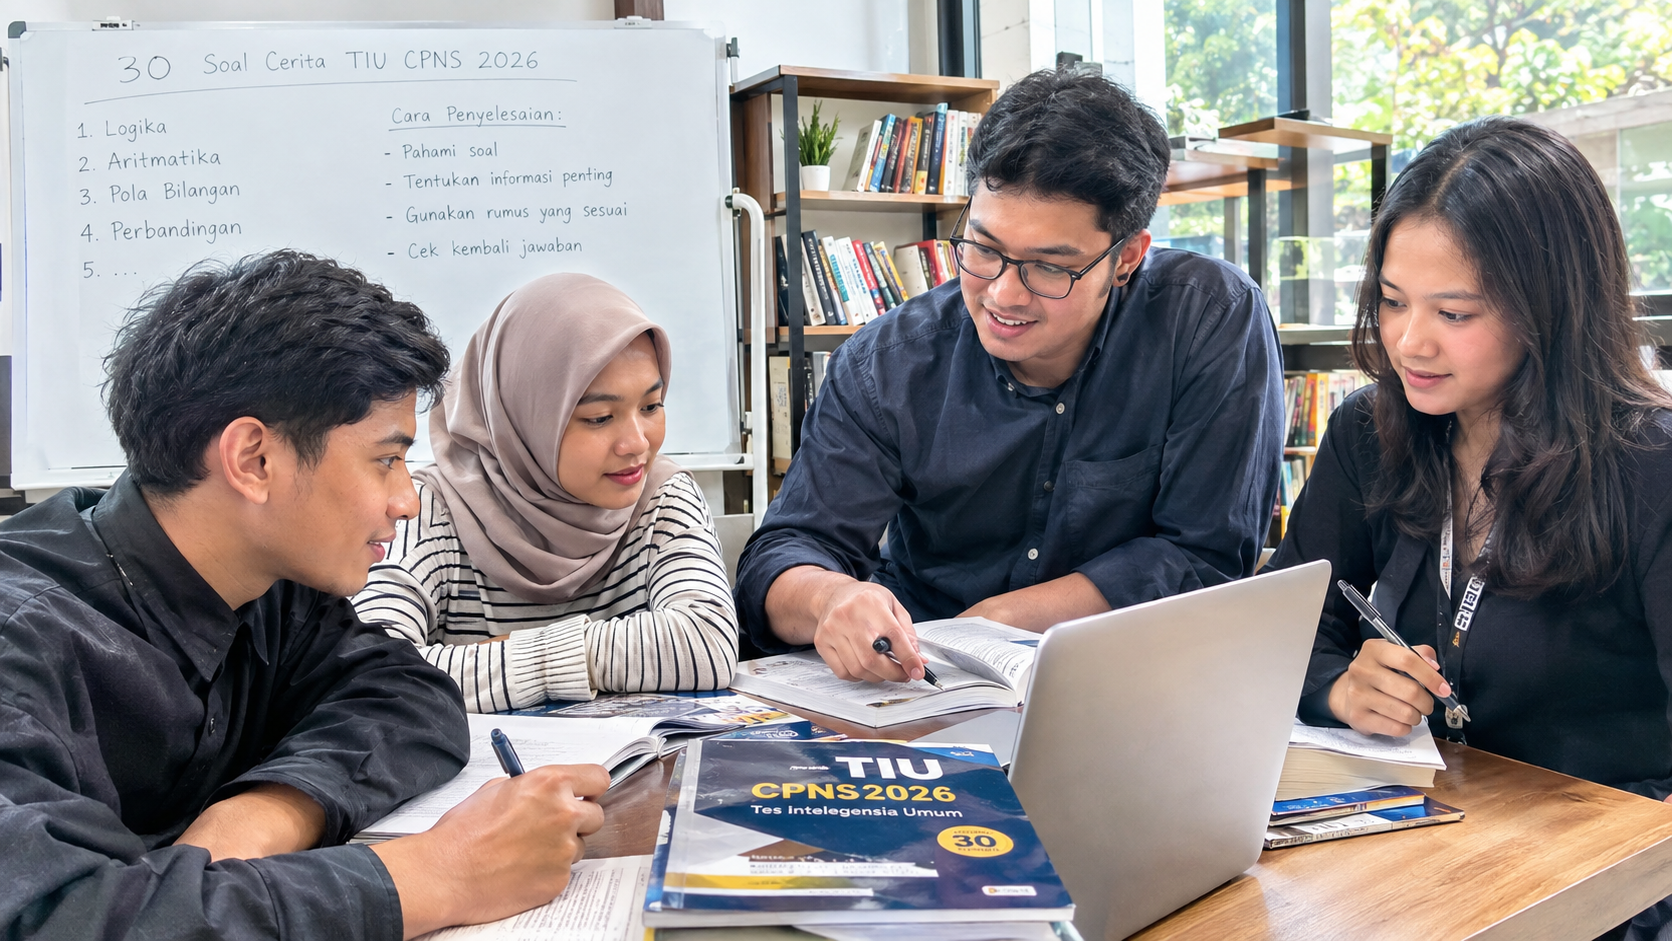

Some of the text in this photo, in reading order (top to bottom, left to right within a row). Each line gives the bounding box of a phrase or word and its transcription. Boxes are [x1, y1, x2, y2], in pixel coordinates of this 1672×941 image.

[117, 50, 539, 83] 30 Soal Cerita TIU CPNS 2026
[391, 104, 563, 128] Cara Penyelesaian:
[77, 118, 167, 143] 1. Logika
[78, 148, 221, 173] 2. Aritmatika
[402, 143, 456, 160] Pahami
[469, 141, 498, 158] soal
[403, 171, 480, 190] Tentukan
[490, 169, 553, 187] informasi
[562, 167, 613, 188] penting
[79, 180, 241, 206] 3. Pola Bilangan
[405, 205, 475, 224] Gunakan
[487, 207, 530, 219] rumus
[539, 206, 572, 225] yang
[583, 202, 628, 217] sesuai
[80, 218, 242, 245] 4. Perbandingan
[408, 242, 439, 260] Cek
[451, 238, 510, 257] kembali
[519, 236, 583, 260] jawaban
[83, 261, 101, 279] 5.
[834, 756, 944, 780] TIU
[750, 805, 782, 815] Tes
[902, 807, 963, 818] Umum
[952, 834, 997, 848] 30
